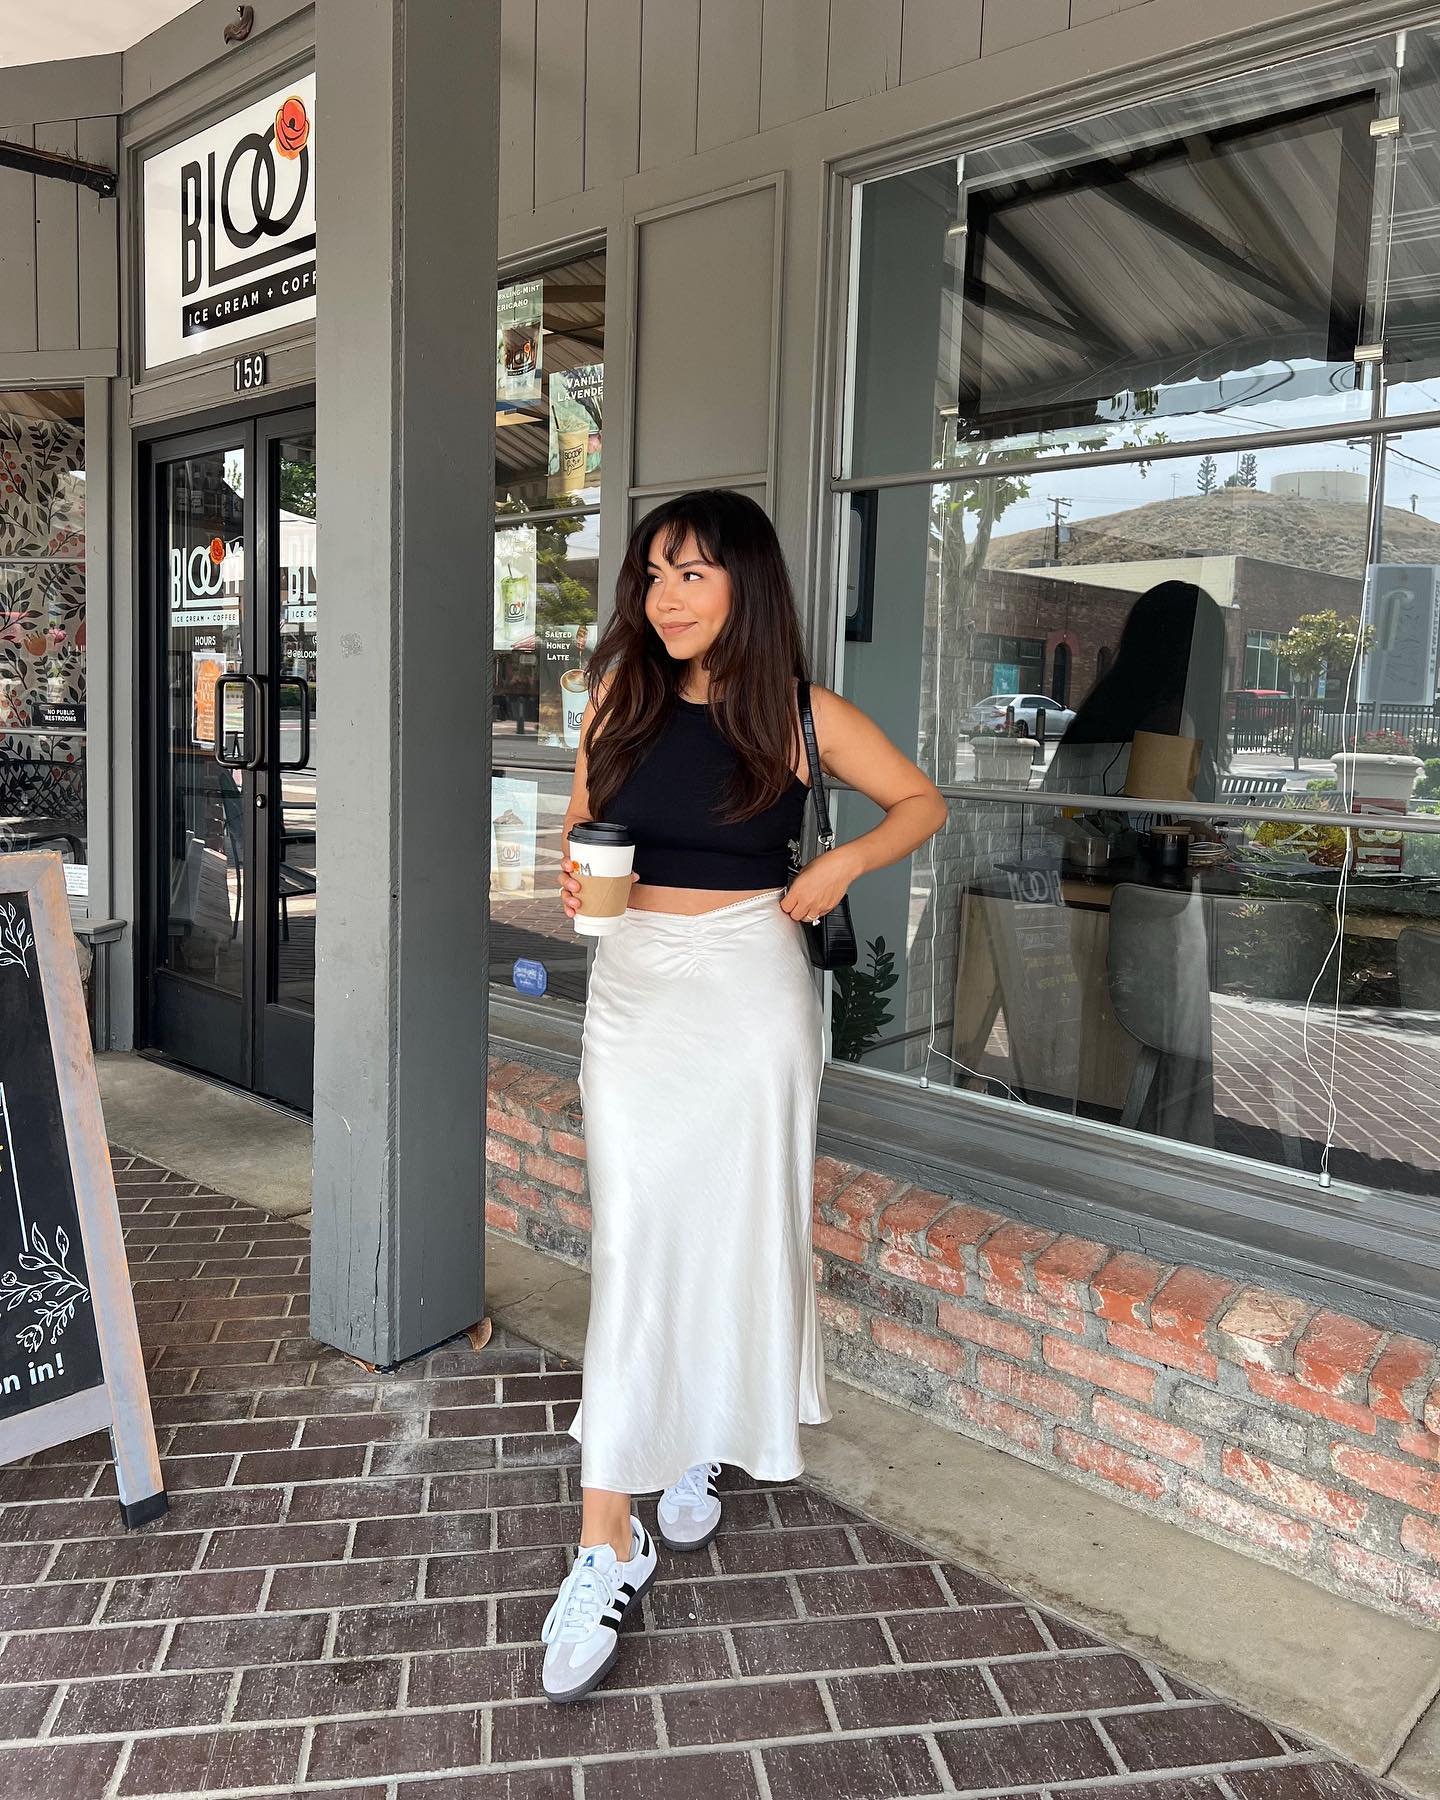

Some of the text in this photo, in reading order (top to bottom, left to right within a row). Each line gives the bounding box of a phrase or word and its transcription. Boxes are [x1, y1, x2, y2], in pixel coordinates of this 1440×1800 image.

[181, 120, 316, 297] BLOO
[188, 308, 209, 327] ICE
[215, 290, 259, 317] CREAM
[236, 355, 262, 390] 159
[171, 541, 240, 609] BLOOM
[194, 635, 217, 646] HOURS
[0, 1351, 65, 1395] n in!
